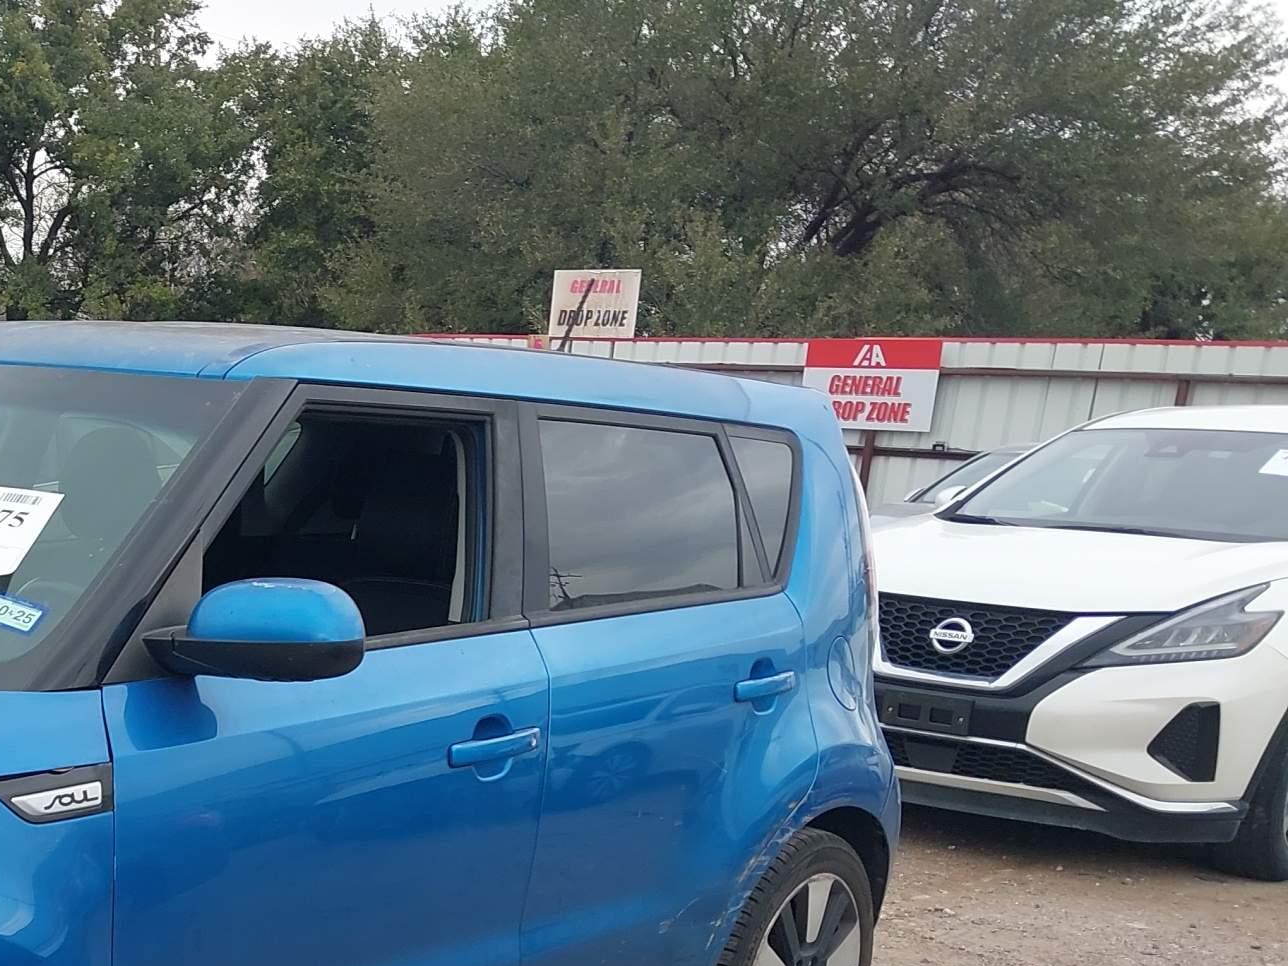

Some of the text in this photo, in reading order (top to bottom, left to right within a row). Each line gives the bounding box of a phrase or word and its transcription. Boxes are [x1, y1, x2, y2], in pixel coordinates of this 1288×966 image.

[593, 310, 628, 327] ZONE
[828, 374, 903, 397] GENERAL
[833, 400, 912, 424] ROP ZONE
[933, 631, 968, 640] NISSAN
[44, 789, 99, 810] SOUL
